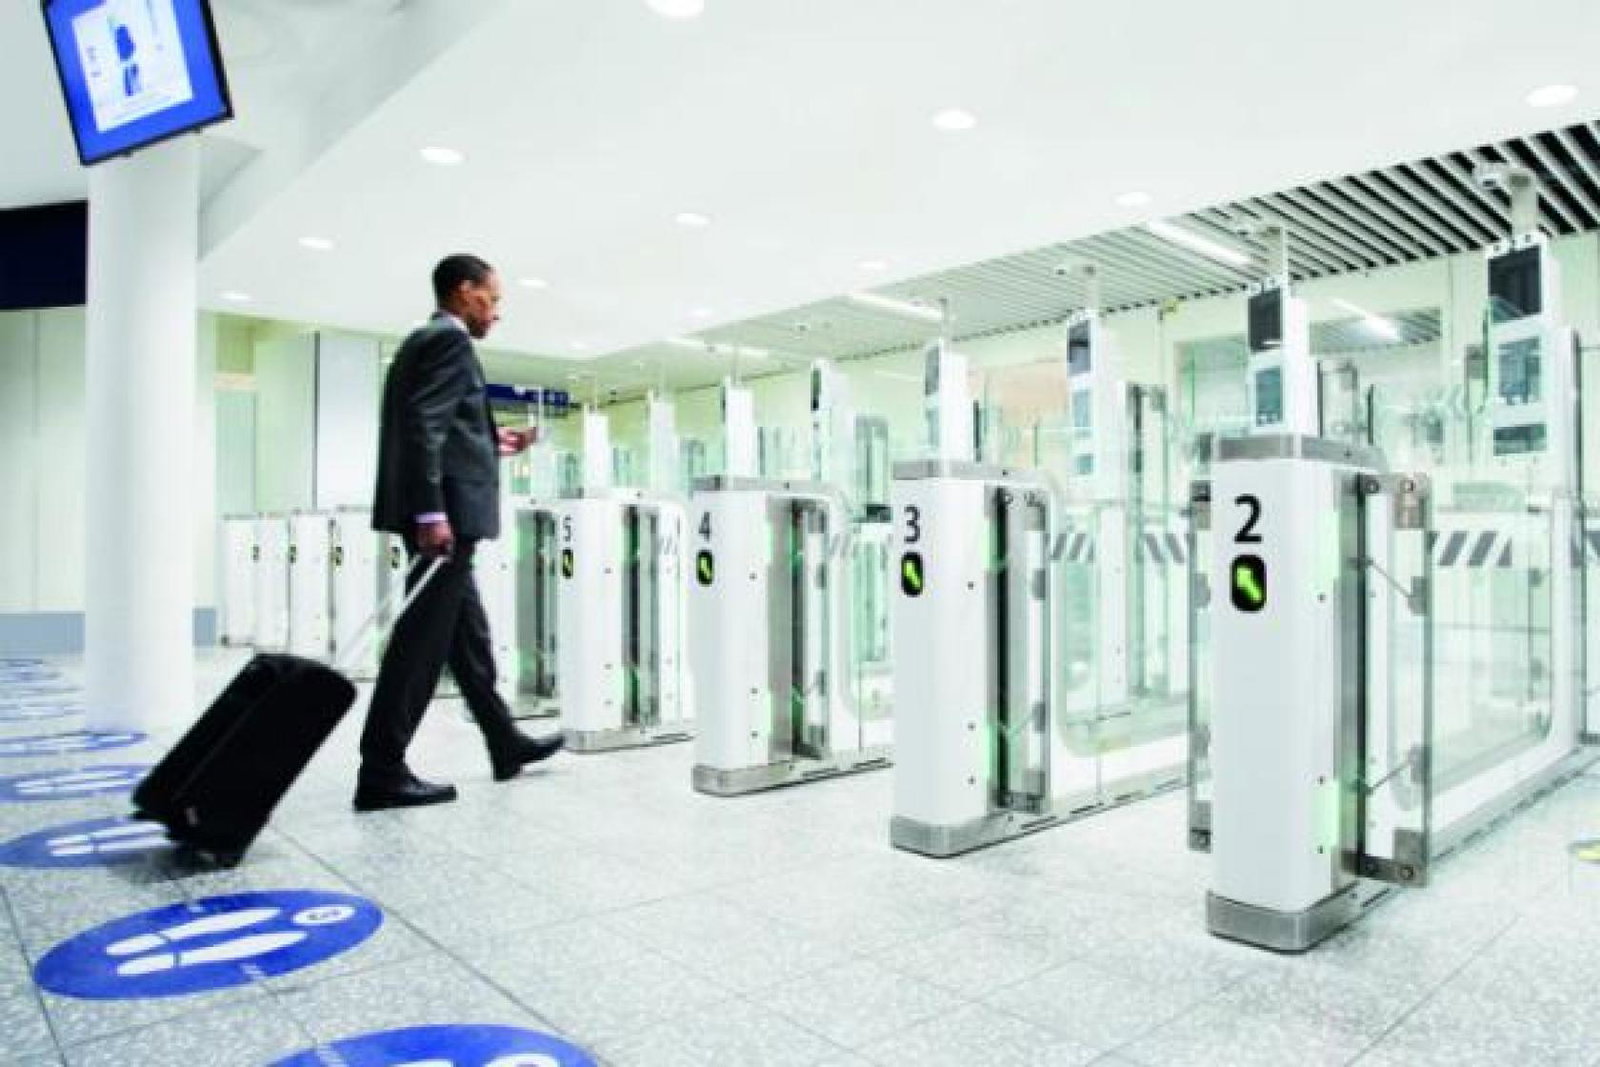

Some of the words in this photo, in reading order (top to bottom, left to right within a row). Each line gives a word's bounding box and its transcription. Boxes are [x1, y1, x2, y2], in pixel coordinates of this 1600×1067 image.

[562, 515, 572, 542] 5
[698, 511, 713, 542] 4
[903, 504, 921, 544] 3
[1233, 493, 1264, 544] 2
